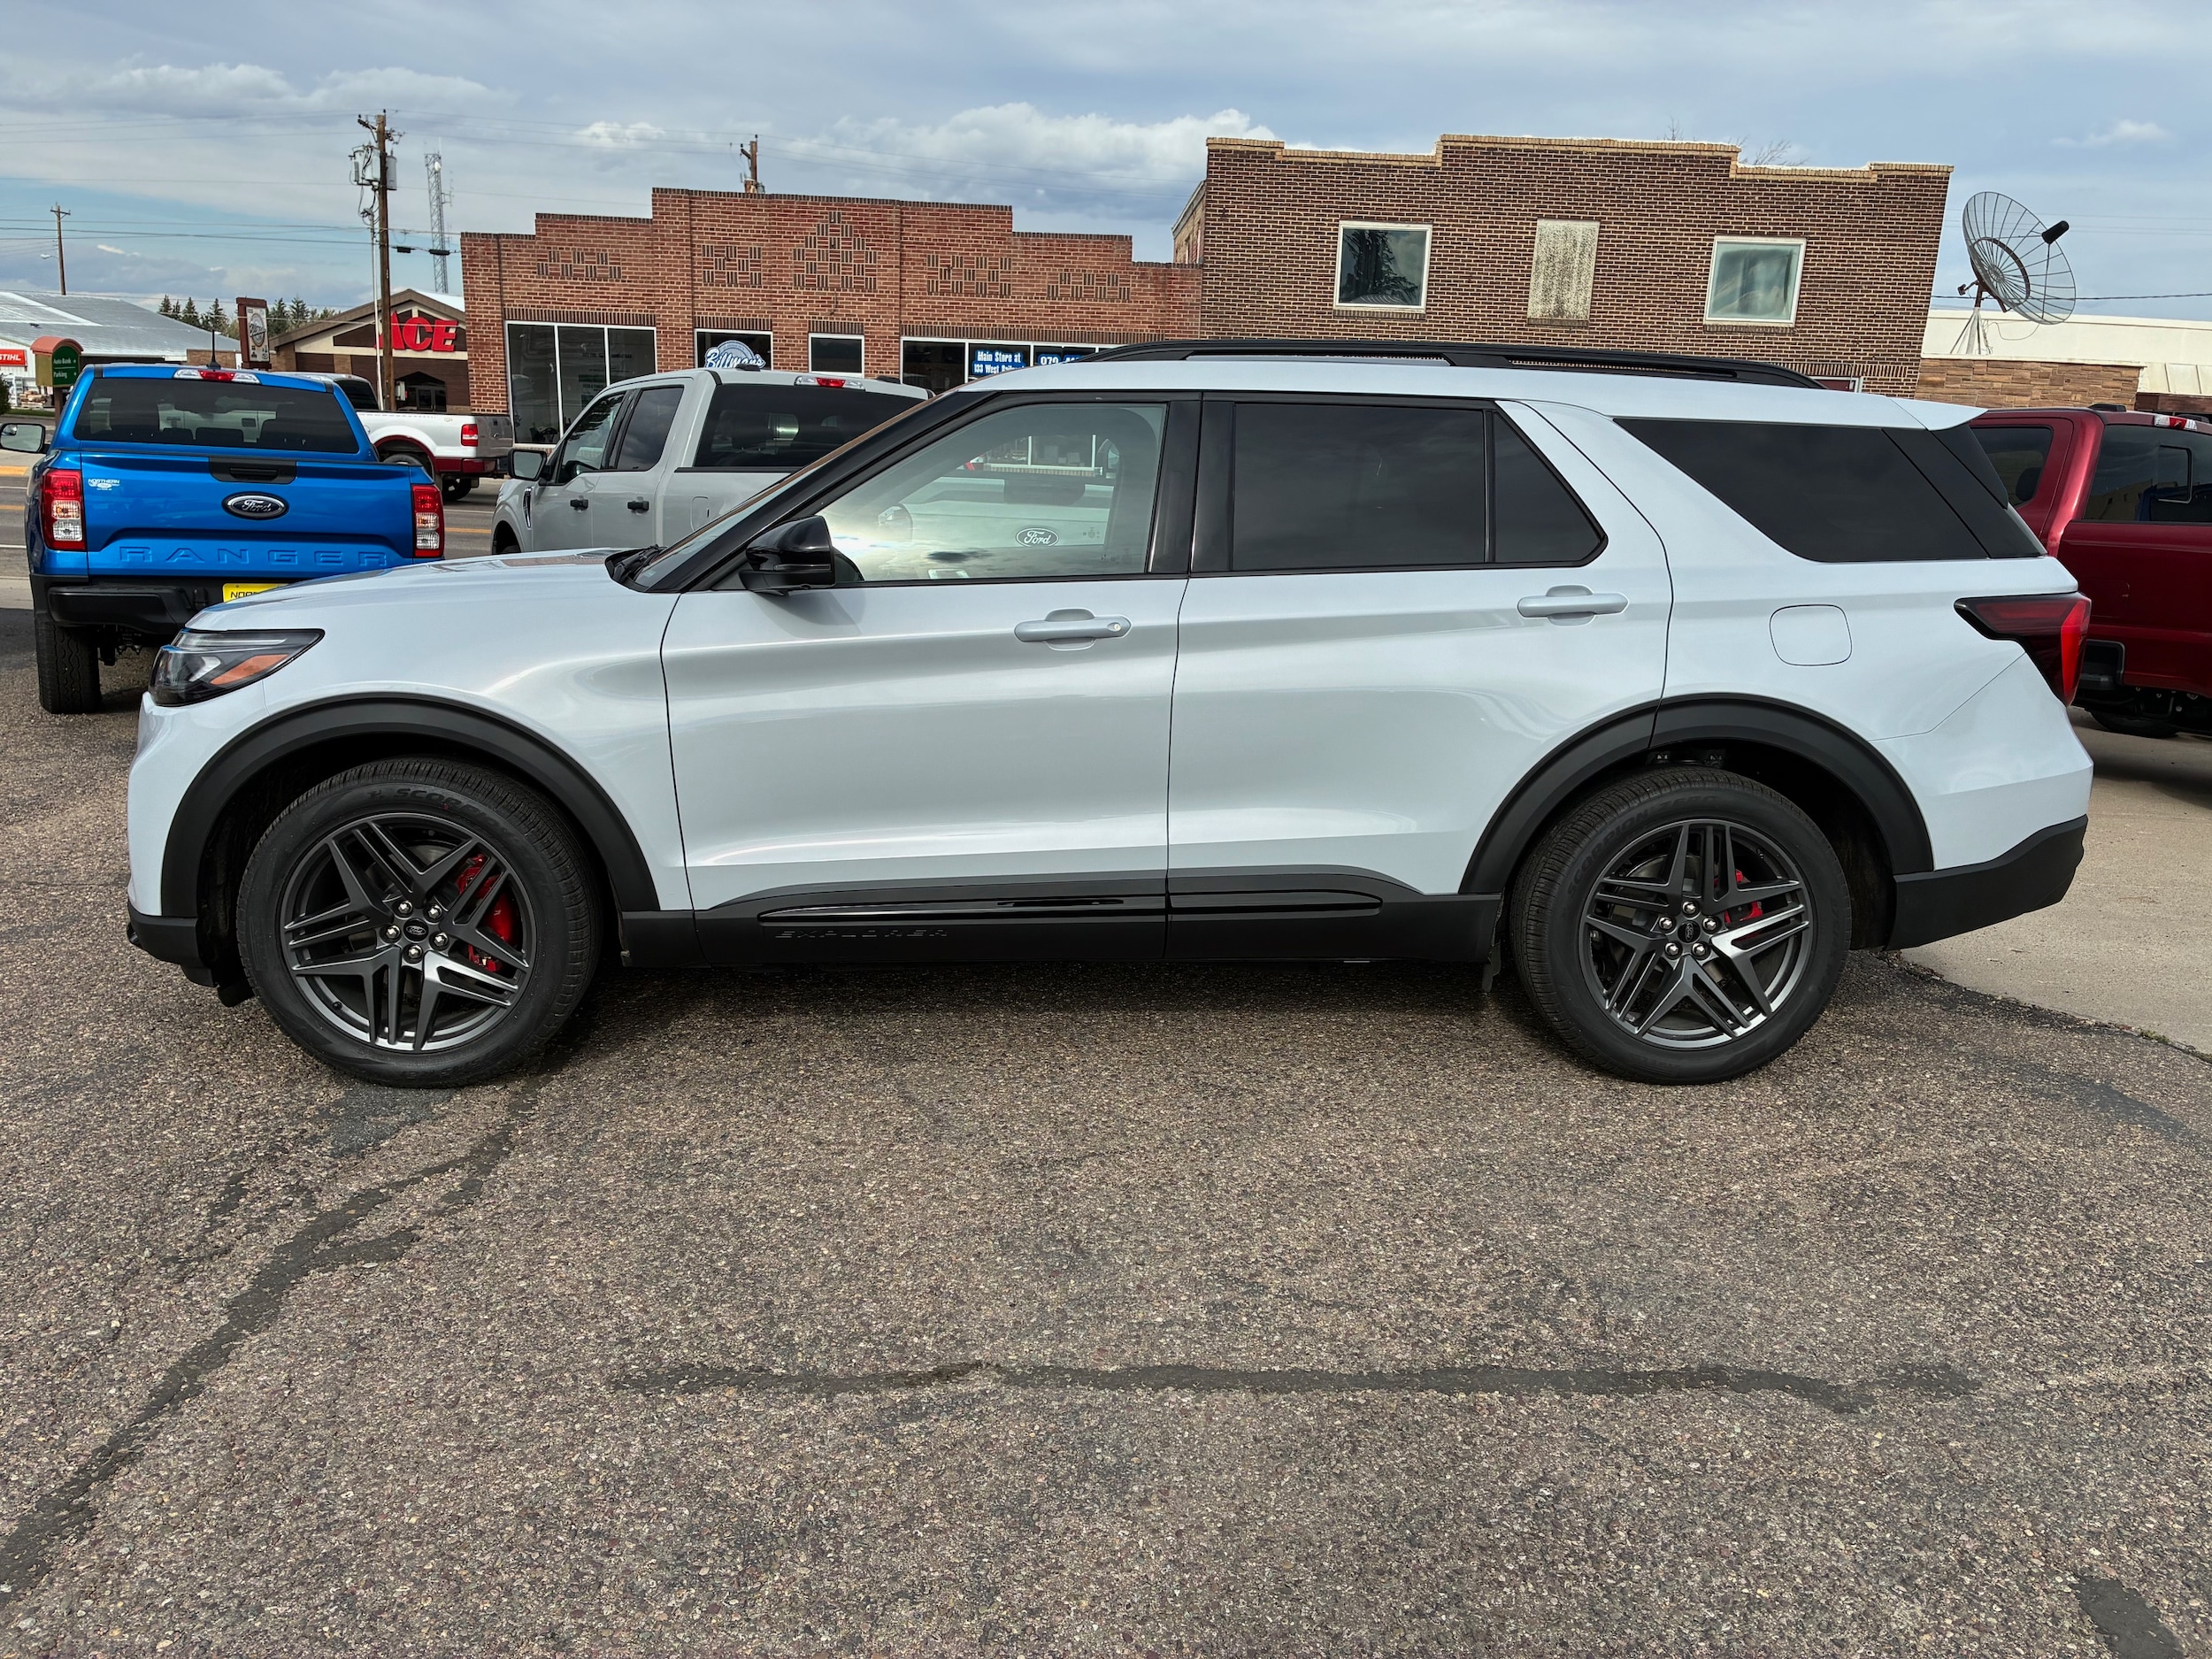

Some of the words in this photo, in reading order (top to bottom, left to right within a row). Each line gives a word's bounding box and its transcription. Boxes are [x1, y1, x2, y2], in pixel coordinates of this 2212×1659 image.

[373, 311, 458, 351] ACE
[977, 351, 993, 362] Main
[995, 352, 1012, 363] Store
[1014, 353, 1021, 363] at
[985, 364, 999, 373] West
[242, 499, 272, 511] Ford
[1024, 530, 1051, 545] Ford
[119, 546, 387, 566] RANGER
